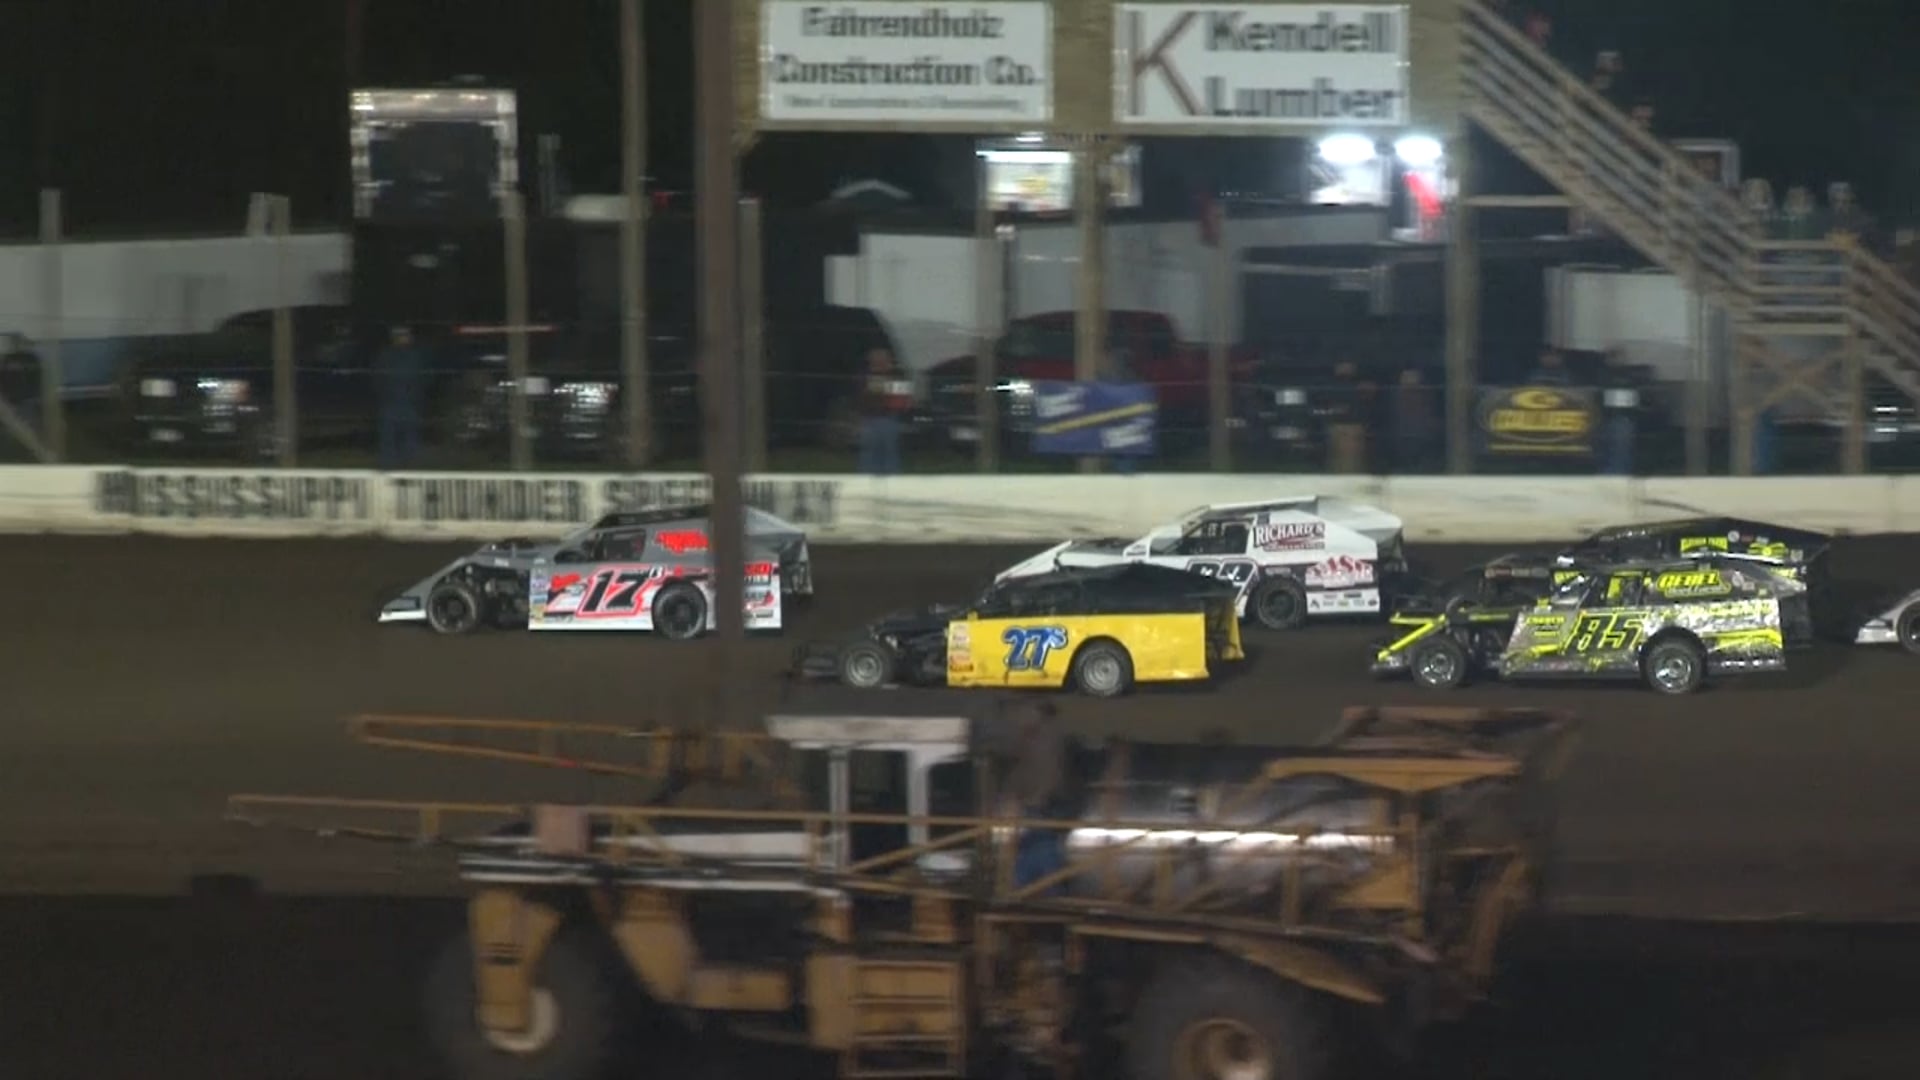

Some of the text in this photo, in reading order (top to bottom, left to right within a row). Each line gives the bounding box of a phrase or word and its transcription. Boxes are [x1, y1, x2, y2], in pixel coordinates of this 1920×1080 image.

[1206, 10, 1397, 53] Kendell
[772, 54, 1045, 86] Construction Co.
[1204, 76, 1403, 118] Lumber
[96, 472, 840, 524] MISSISSIPPI THUNDER SPEEWAY
[1562, 611, 1649, 652] 85
